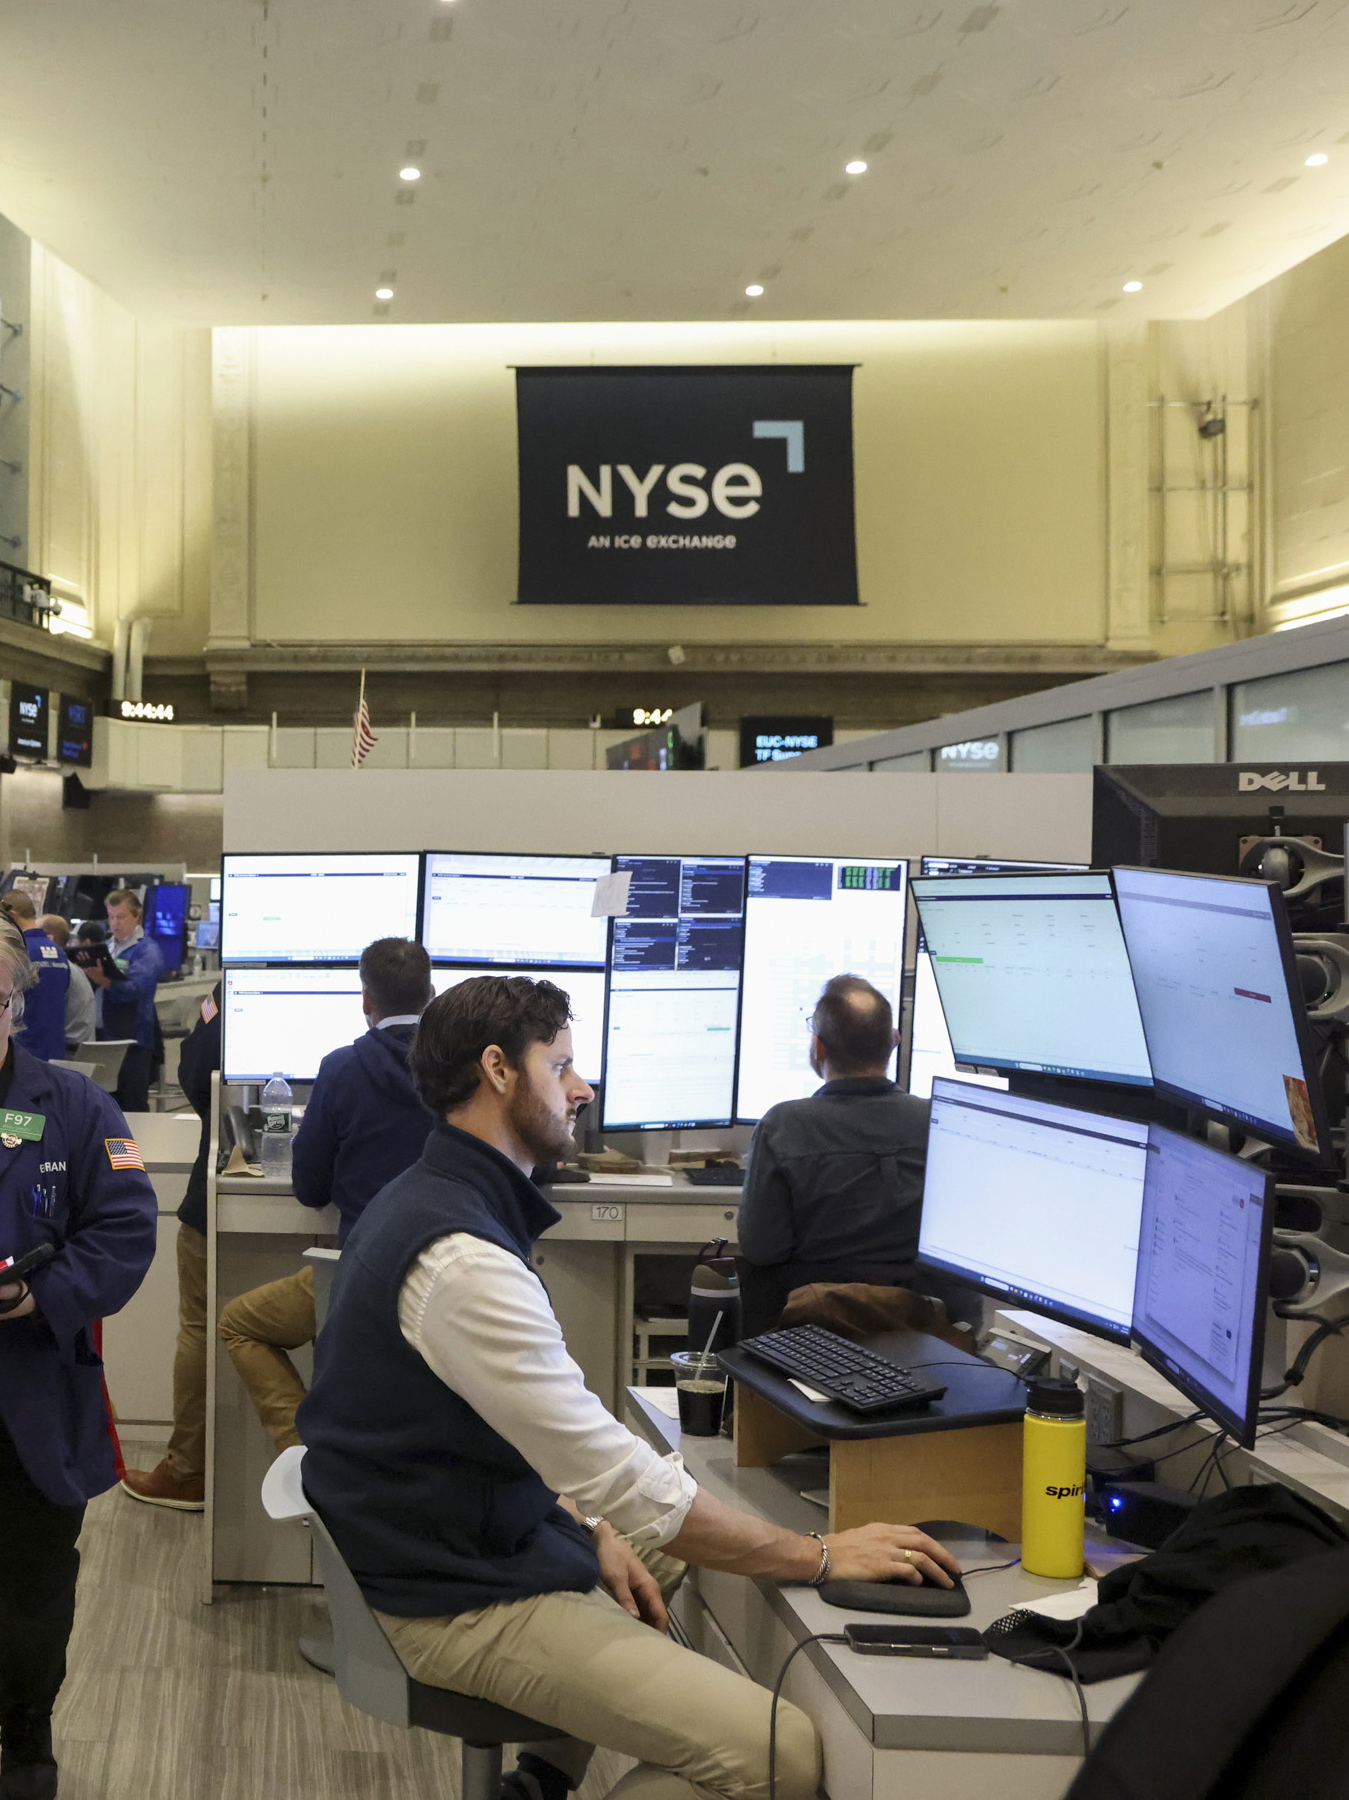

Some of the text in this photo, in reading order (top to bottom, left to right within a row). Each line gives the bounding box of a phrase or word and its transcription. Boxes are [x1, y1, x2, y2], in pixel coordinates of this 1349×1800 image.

[588, 536, 610, 549] AN
[121, 701, 174, 721] 9:44:44
[754, 748, 771, 761] TF
[1238, 771, 1326, 792] DELL
[4, 1113, 33, 1127] F97
[595, 1206, 619, 1219] 170
